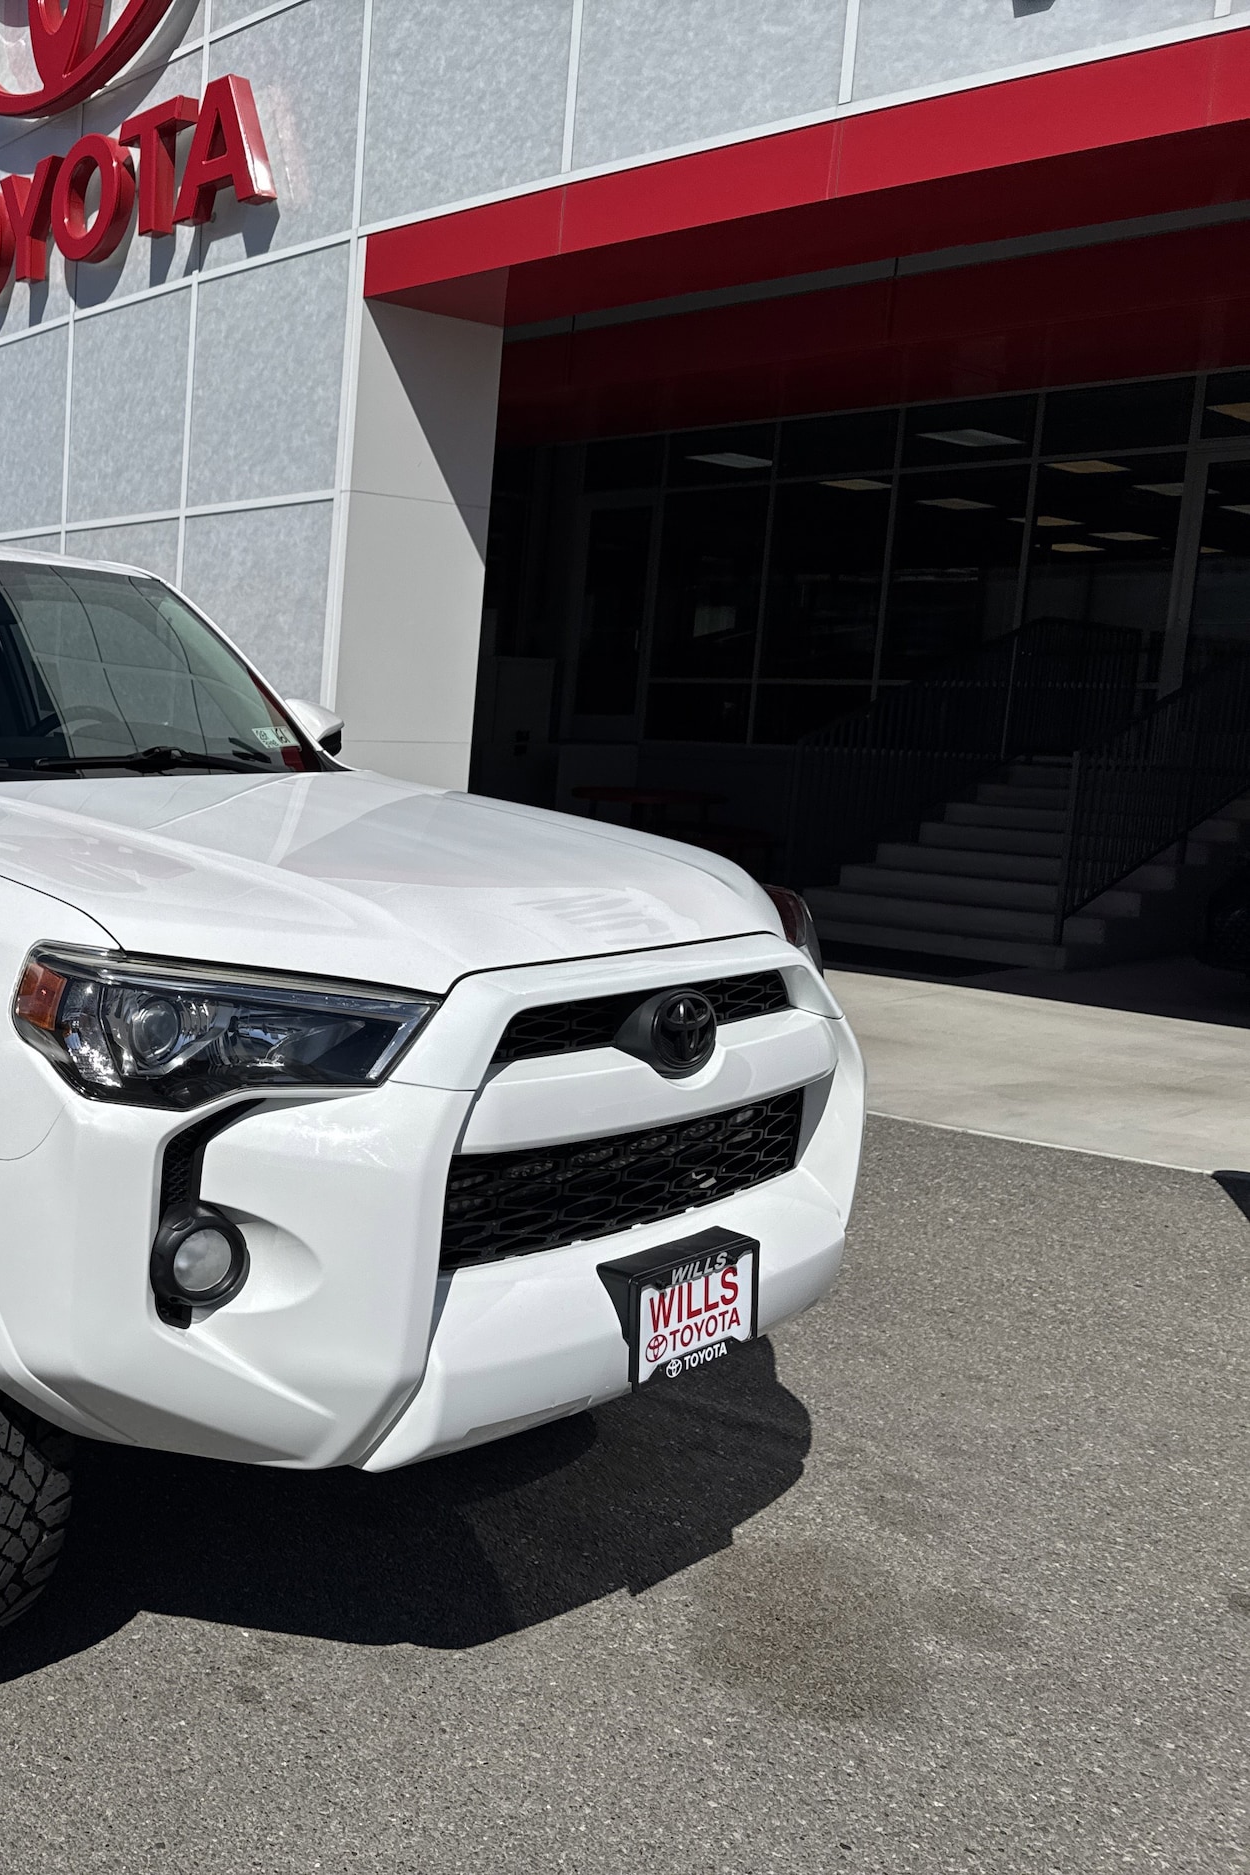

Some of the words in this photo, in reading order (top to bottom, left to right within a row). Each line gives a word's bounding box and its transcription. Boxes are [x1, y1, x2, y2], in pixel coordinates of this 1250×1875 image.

[671, 1251, 728, 1285] WILLS
[649, 1266, 738, 1333] WILLS
[669, 1307, 740, 1351] TOYOTA
[684, 1341, 727, 1370] TOYOTA
